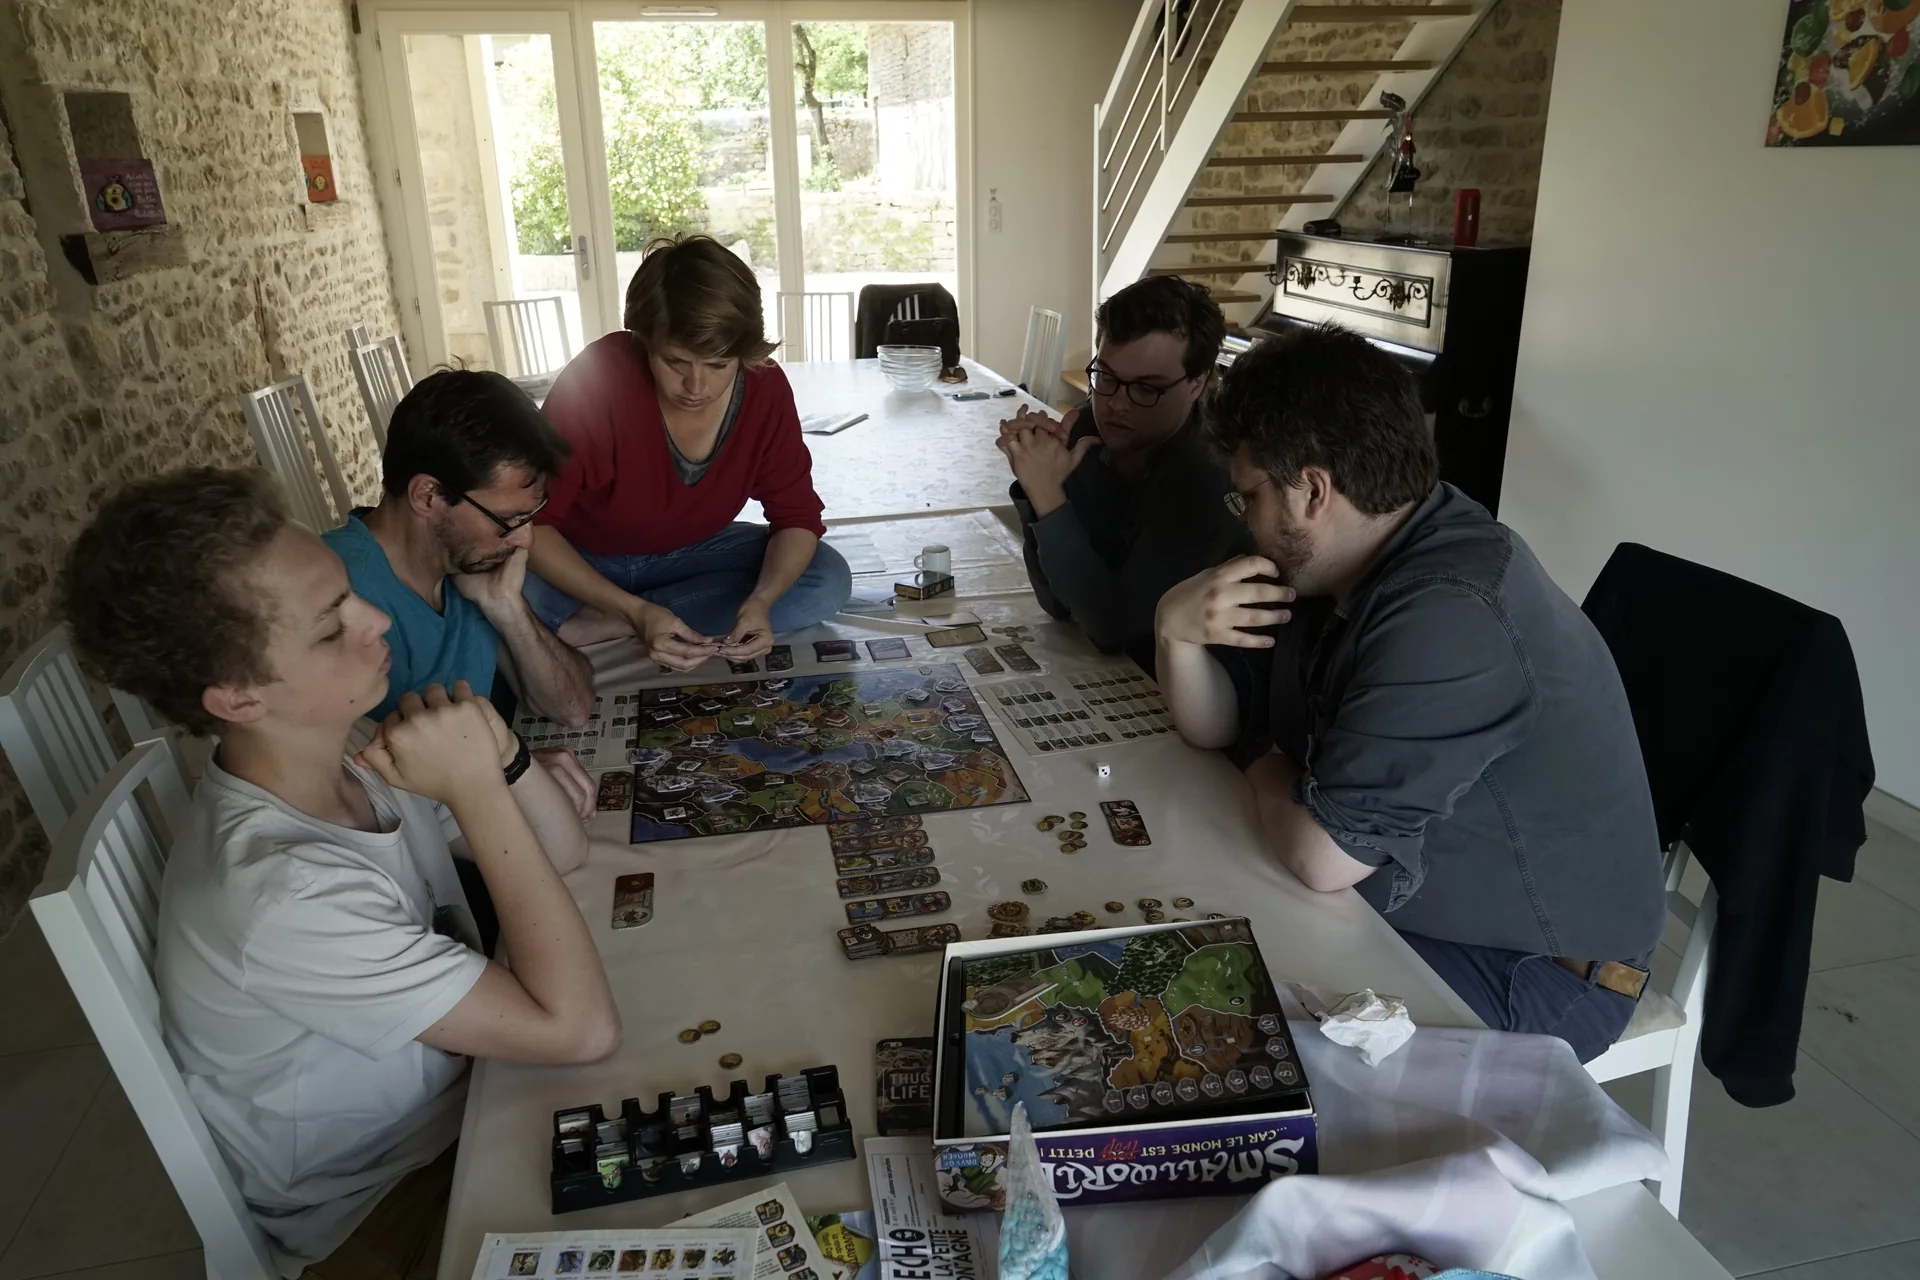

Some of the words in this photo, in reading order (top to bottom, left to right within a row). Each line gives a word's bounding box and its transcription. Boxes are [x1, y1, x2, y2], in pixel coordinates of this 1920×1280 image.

[1262, 1019, 1275, 1031] 10
[1271, 1045, 1283, 1054] 9
[890, 1071, 931, 1085] THUG
[890, 1085, 931, 1099] LIFE
[1171, 1139, 1221, 1152] MONDE
[1227, 1136, 1243, 1148] LE
[943, 1151, 977, 1162] WONDER
[1048, 1147, 1095, 1159] PETIT
[1141, 1145, 1166, 1157] EST
[944, 1158, 955, 1167] OF
[956, 1158, 977, 1167] DAYS
[928, 1229, 950, 1262] PETITE
[934, 1263, 953, 1277] LA
